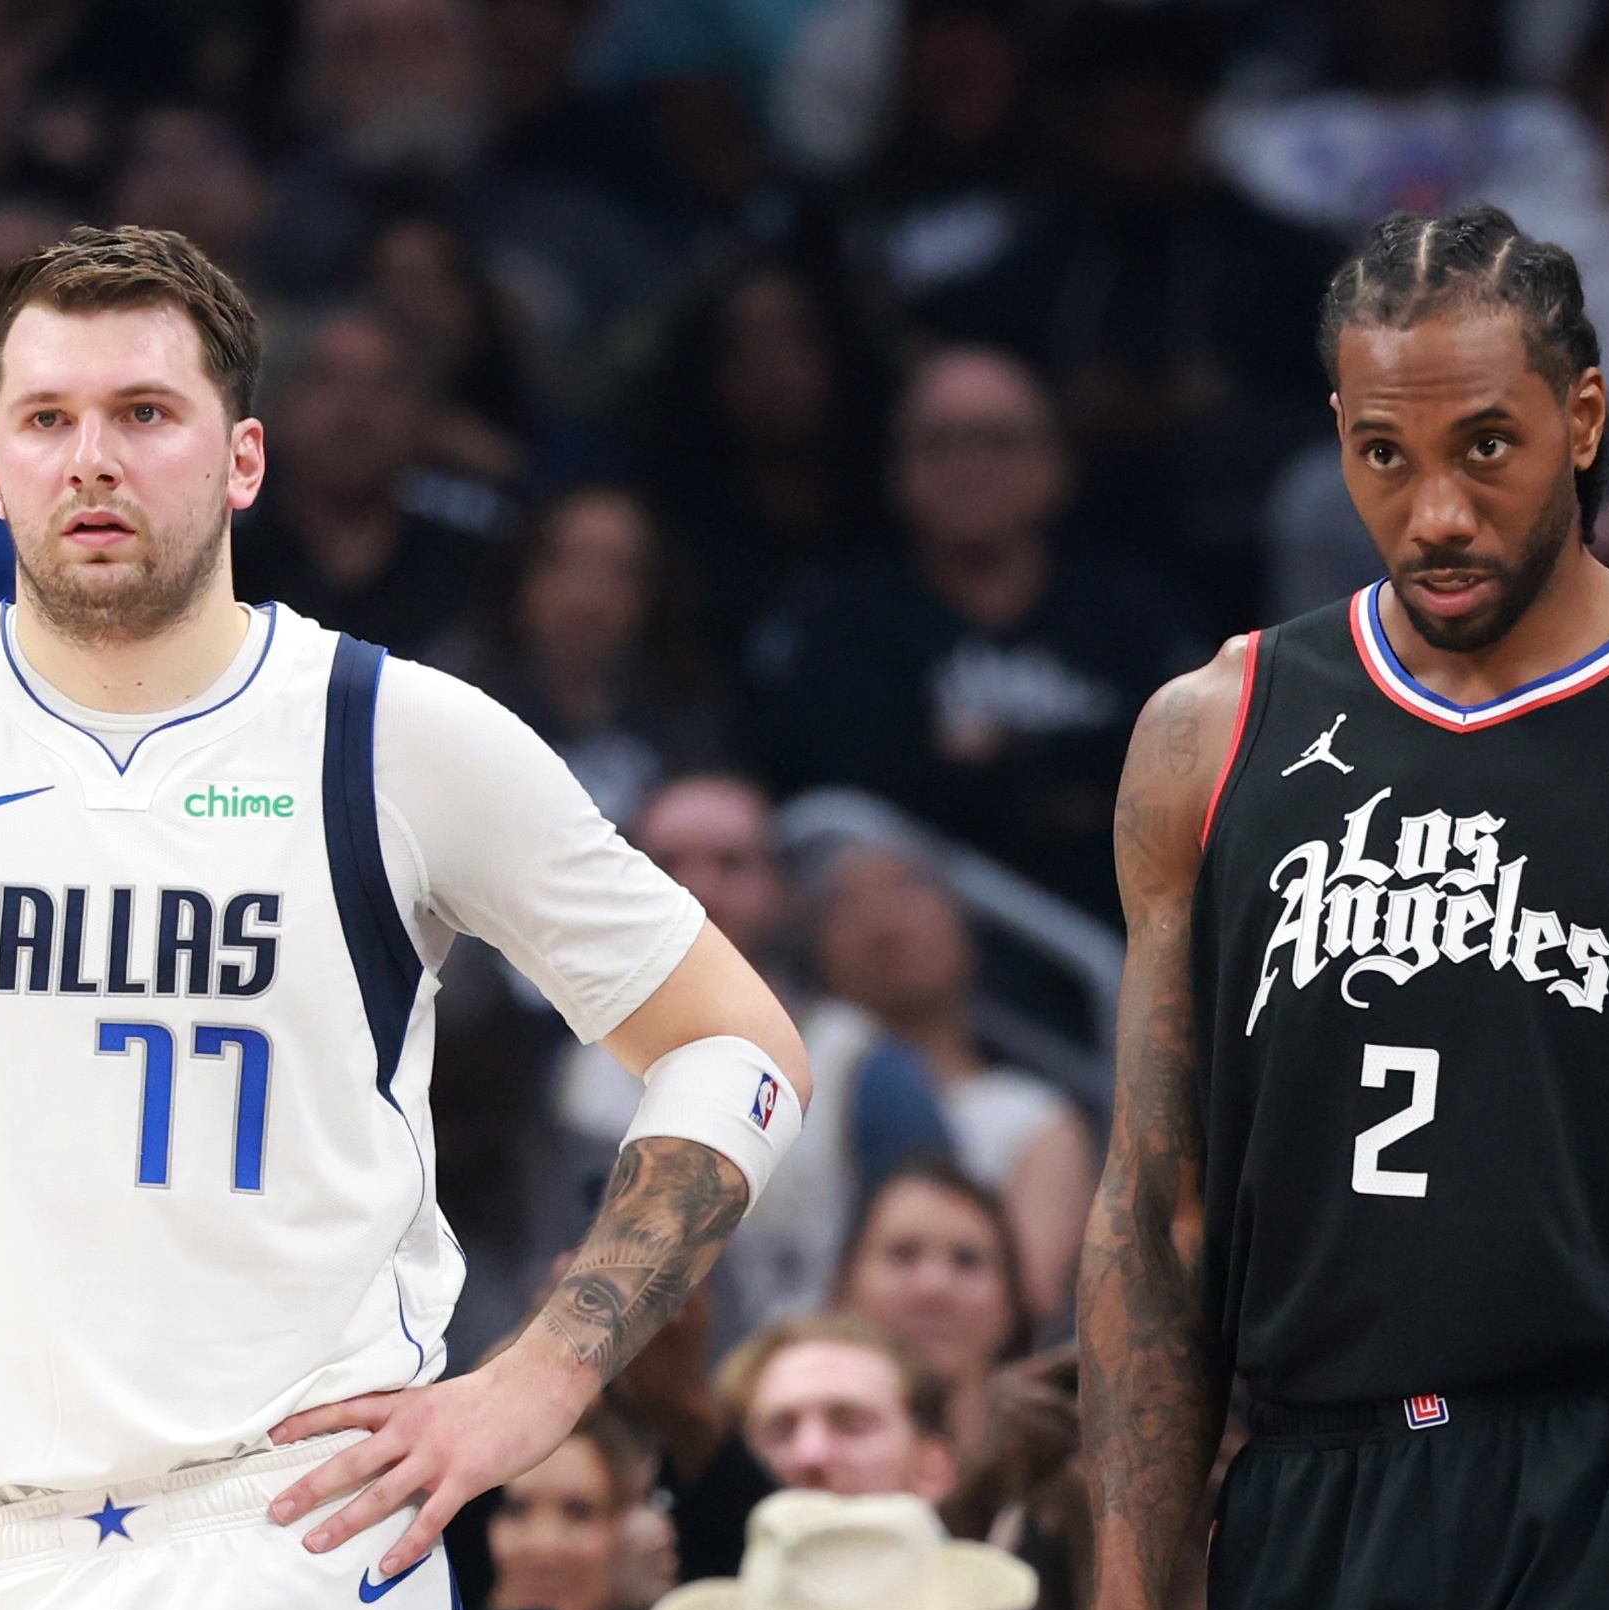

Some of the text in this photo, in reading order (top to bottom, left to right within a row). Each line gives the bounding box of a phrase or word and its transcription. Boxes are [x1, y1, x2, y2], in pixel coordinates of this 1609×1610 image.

[184, 784, 294, 818] chime
[1324, 786, 1506, 892] Los
[94, 1018, 274, 1195] 77
[1351, 1043, 1440, 1198] 2
